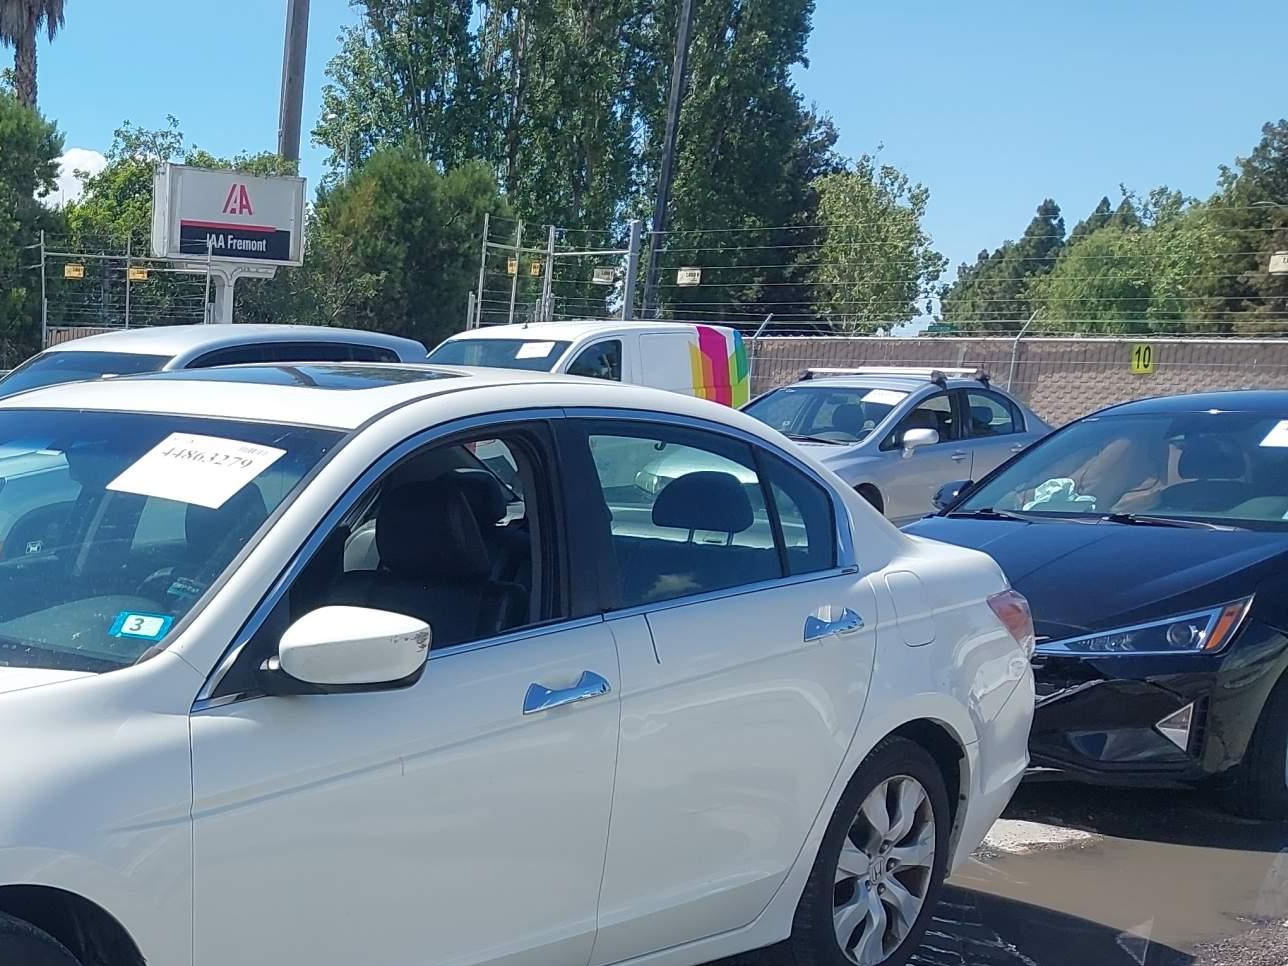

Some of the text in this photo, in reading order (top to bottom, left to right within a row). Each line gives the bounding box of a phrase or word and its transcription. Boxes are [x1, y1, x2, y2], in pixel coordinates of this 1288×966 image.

[227, 235, 267, 252] Fremont
[1135, 345, 1152, 369] 10
[161, 447, 254, 469] 44863279
[128, 617, 145, 632] 3
